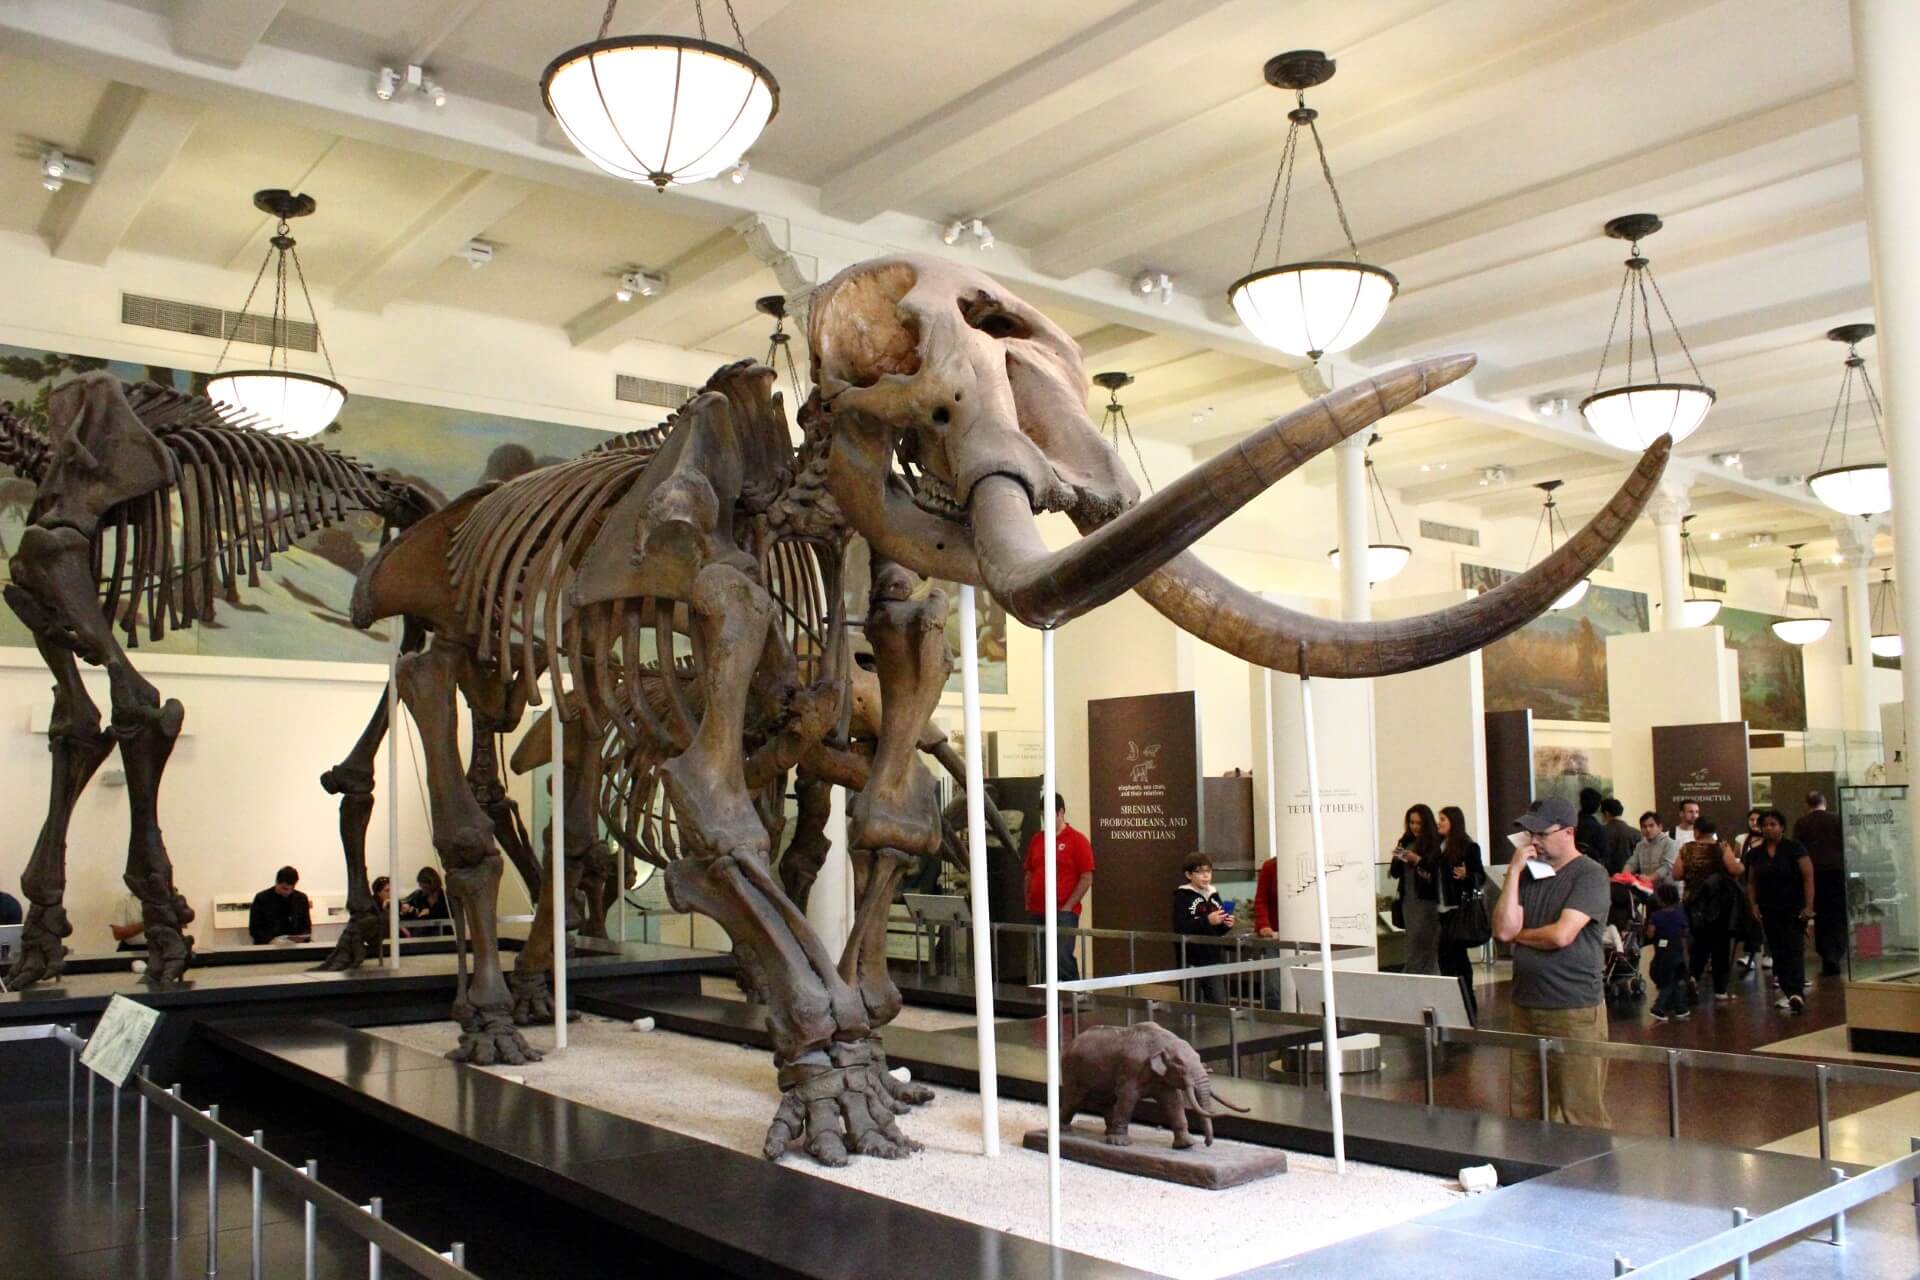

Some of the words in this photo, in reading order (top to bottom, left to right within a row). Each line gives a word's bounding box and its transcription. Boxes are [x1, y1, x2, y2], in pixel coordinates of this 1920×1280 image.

[1120, 805, 1164, 815] SIRENIANS,
[1099, 817, 1167, 828] PROBOSCIDEANS,
[1169, 817, 1188, 827] AND
[1111, 830, 1176, 840] DESMOSTYLIANS
